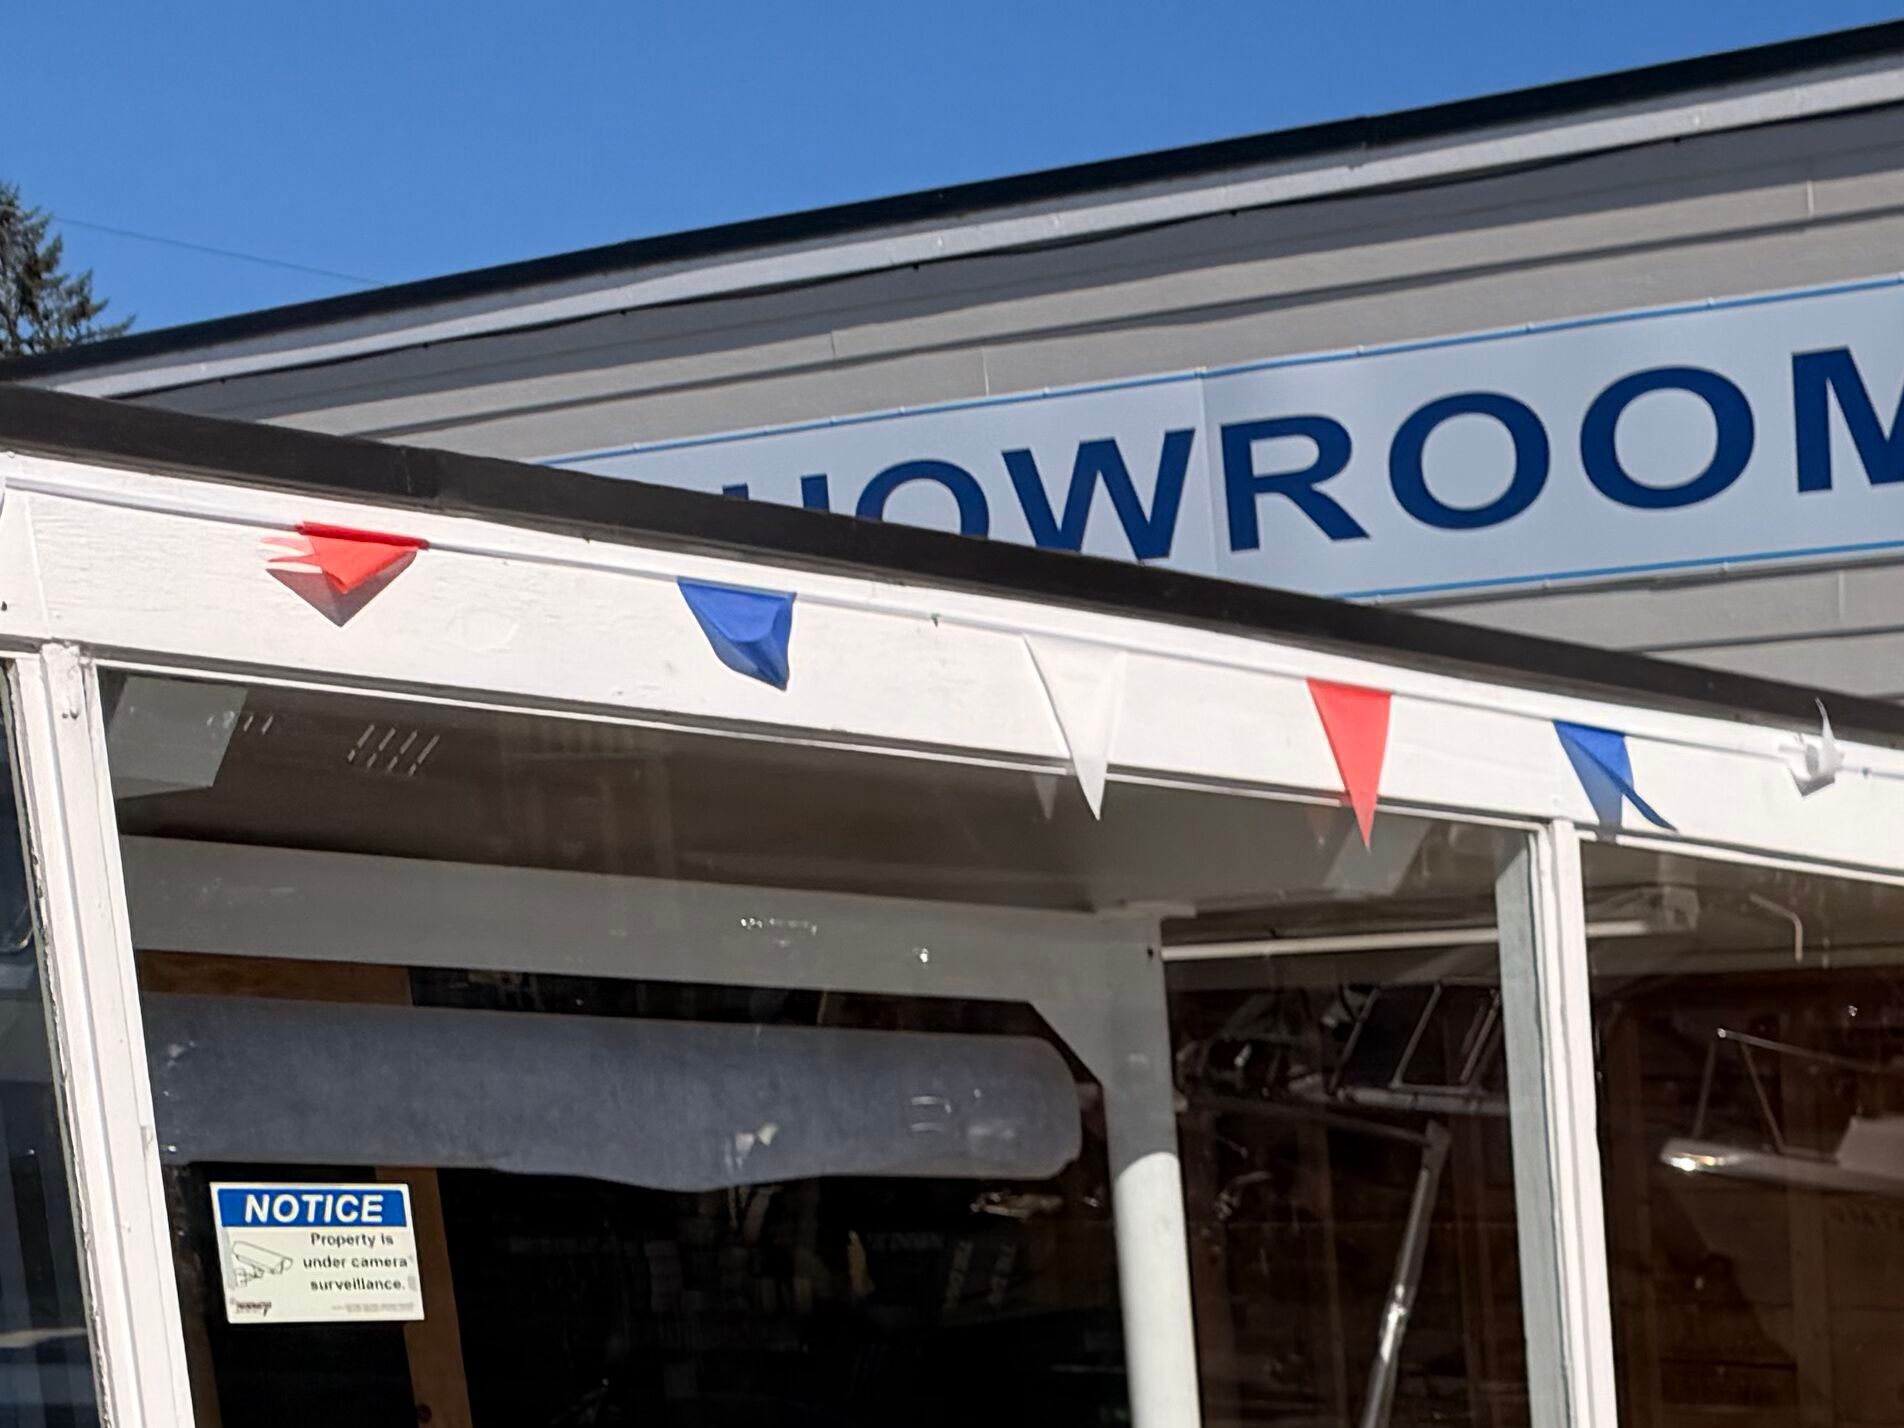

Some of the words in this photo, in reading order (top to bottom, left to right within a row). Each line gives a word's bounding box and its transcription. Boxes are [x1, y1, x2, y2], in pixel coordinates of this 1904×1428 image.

[244, 1194, 384, 1224] NOTICE
[310, 1232, 376, 1249] Property
[380, 1232, 394, 1246] is
[303, 1255, 346, 1269] under
[351, 1256, 408, 1269] camera
[310, 1275, 406, 1291] surveillance.
